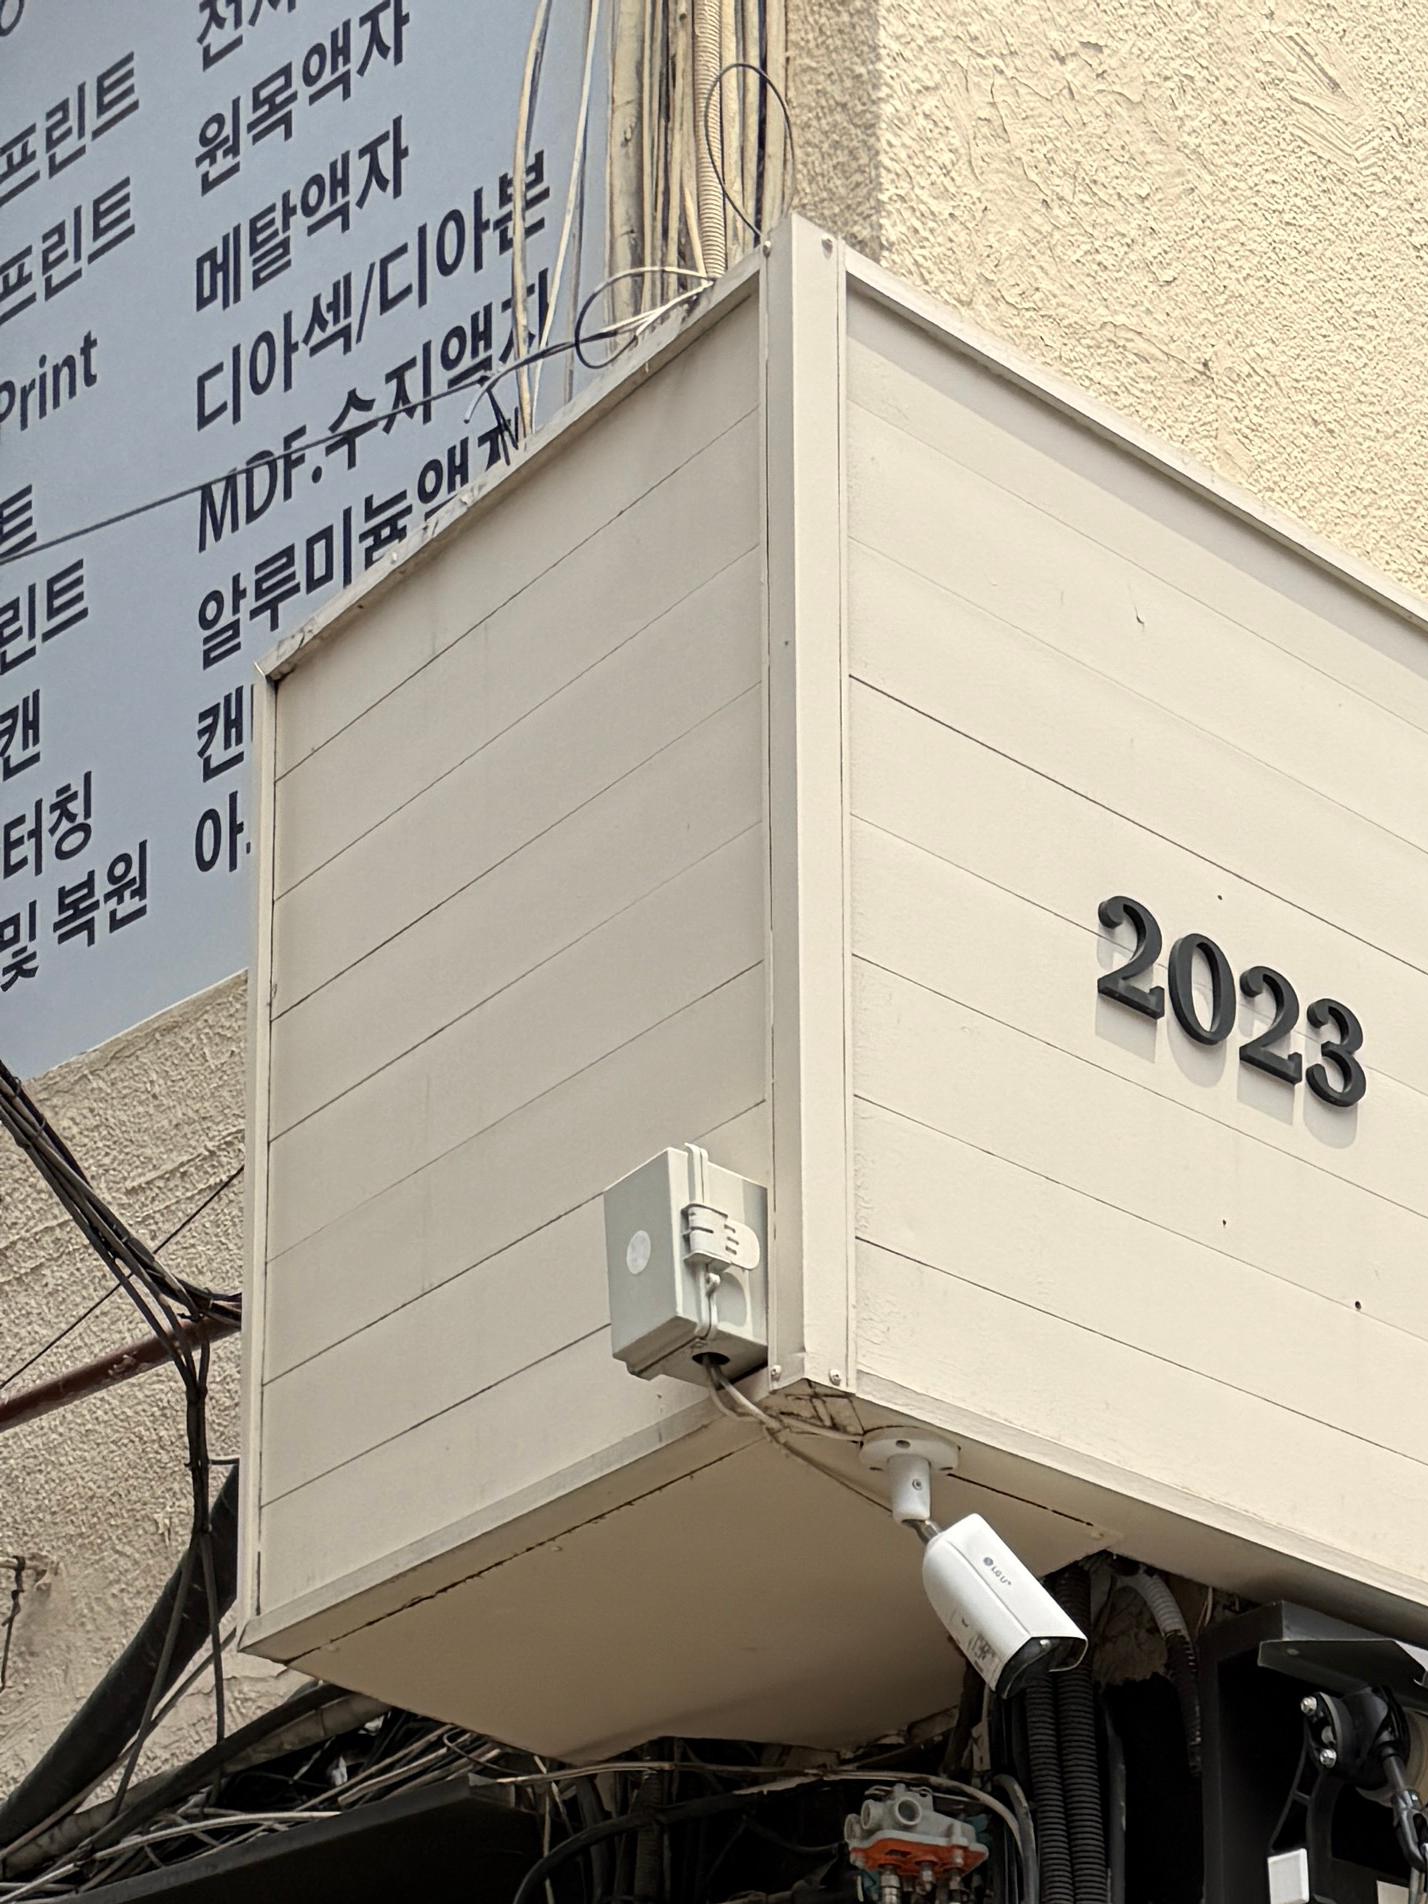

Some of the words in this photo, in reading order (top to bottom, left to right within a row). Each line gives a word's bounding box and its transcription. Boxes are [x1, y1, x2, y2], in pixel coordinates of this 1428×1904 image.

[0, 51, 139, 206] 프린트
[194, 0, 410, 197] 원목액자
[0, 176, 135, 326] 프린트
[196, 114, 410, 312] 메탈액자
[197, 685, 254, 784] 캔
[53, 840, 148, 947] 복원
[195, 791, 251, 873] 아
[1098, 893, 1367, 1111] 2023
